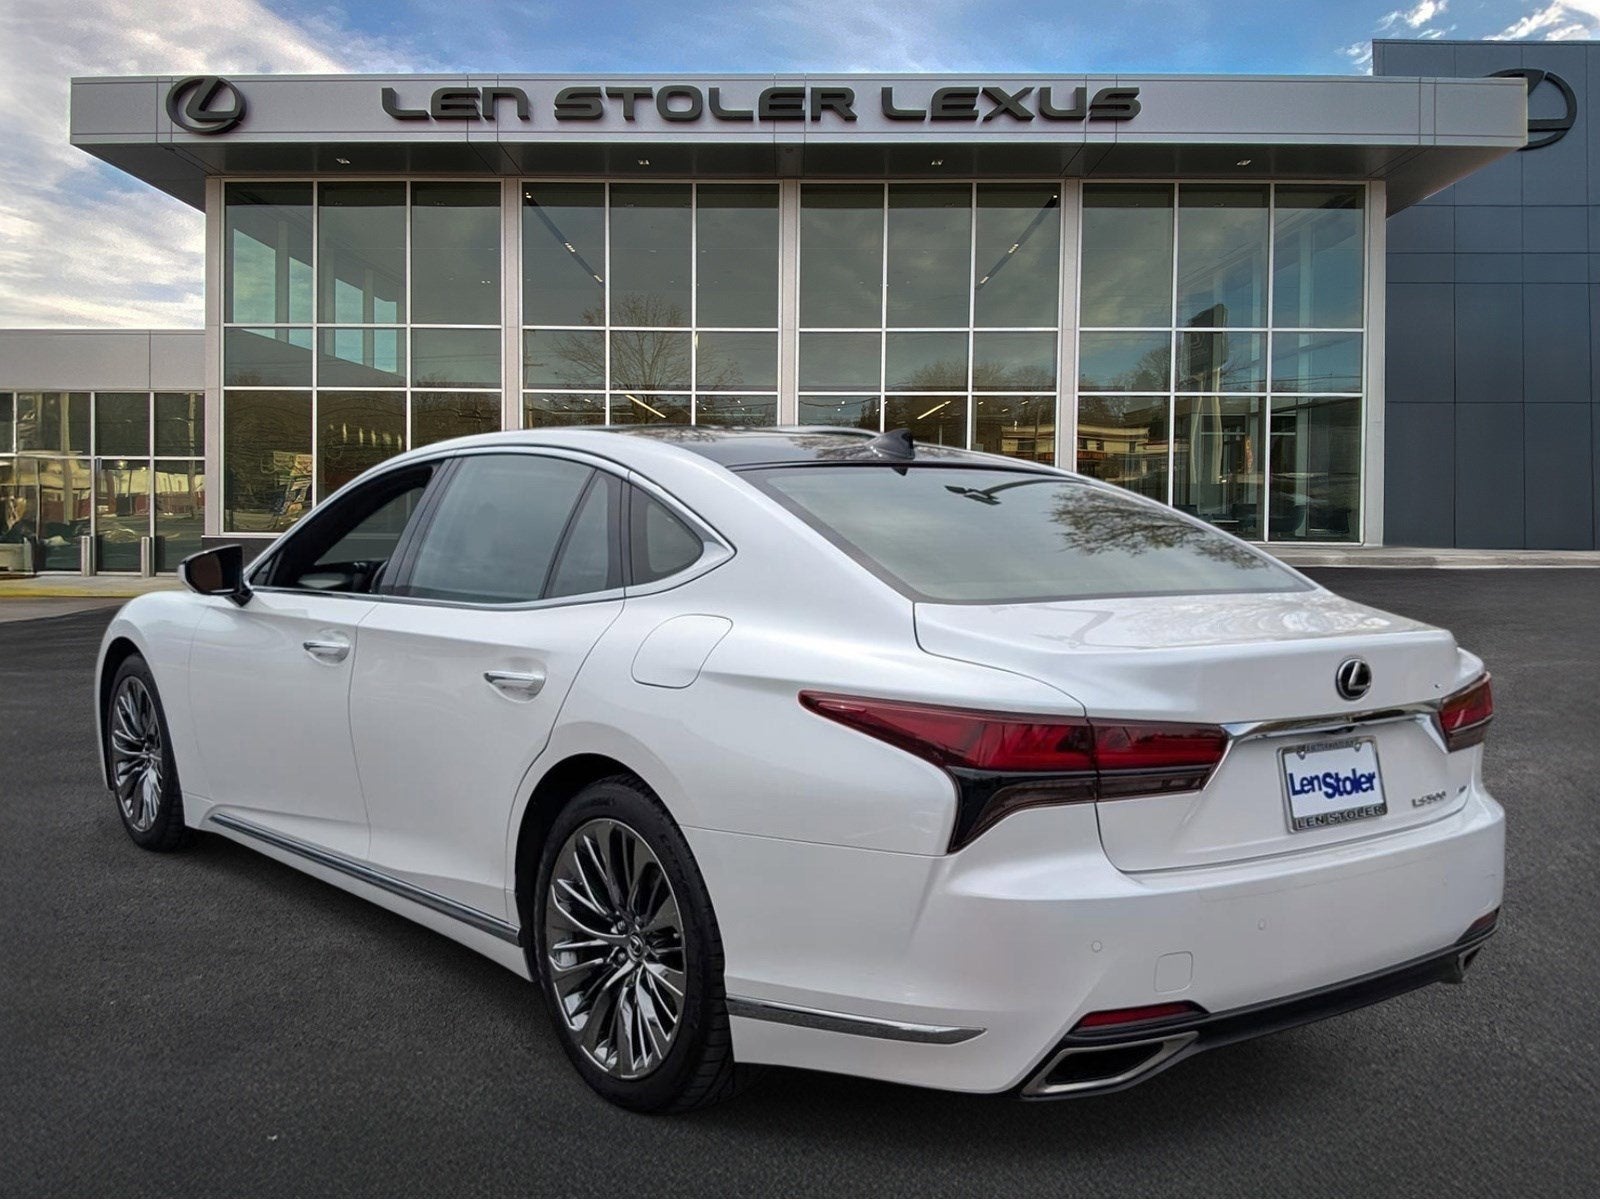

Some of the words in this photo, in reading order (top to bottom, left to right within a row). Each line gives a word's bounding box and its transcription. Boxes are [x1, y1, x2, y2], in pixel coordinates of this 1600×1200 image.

[381, 87, 530, 121] LEN
[554, 85, 858, 122] STOLER
[881, 87, 1142, 121] LEXUS
[1296, 816, 1326, 830] LEN
[1328, 806, 1382, 825] STOLER
